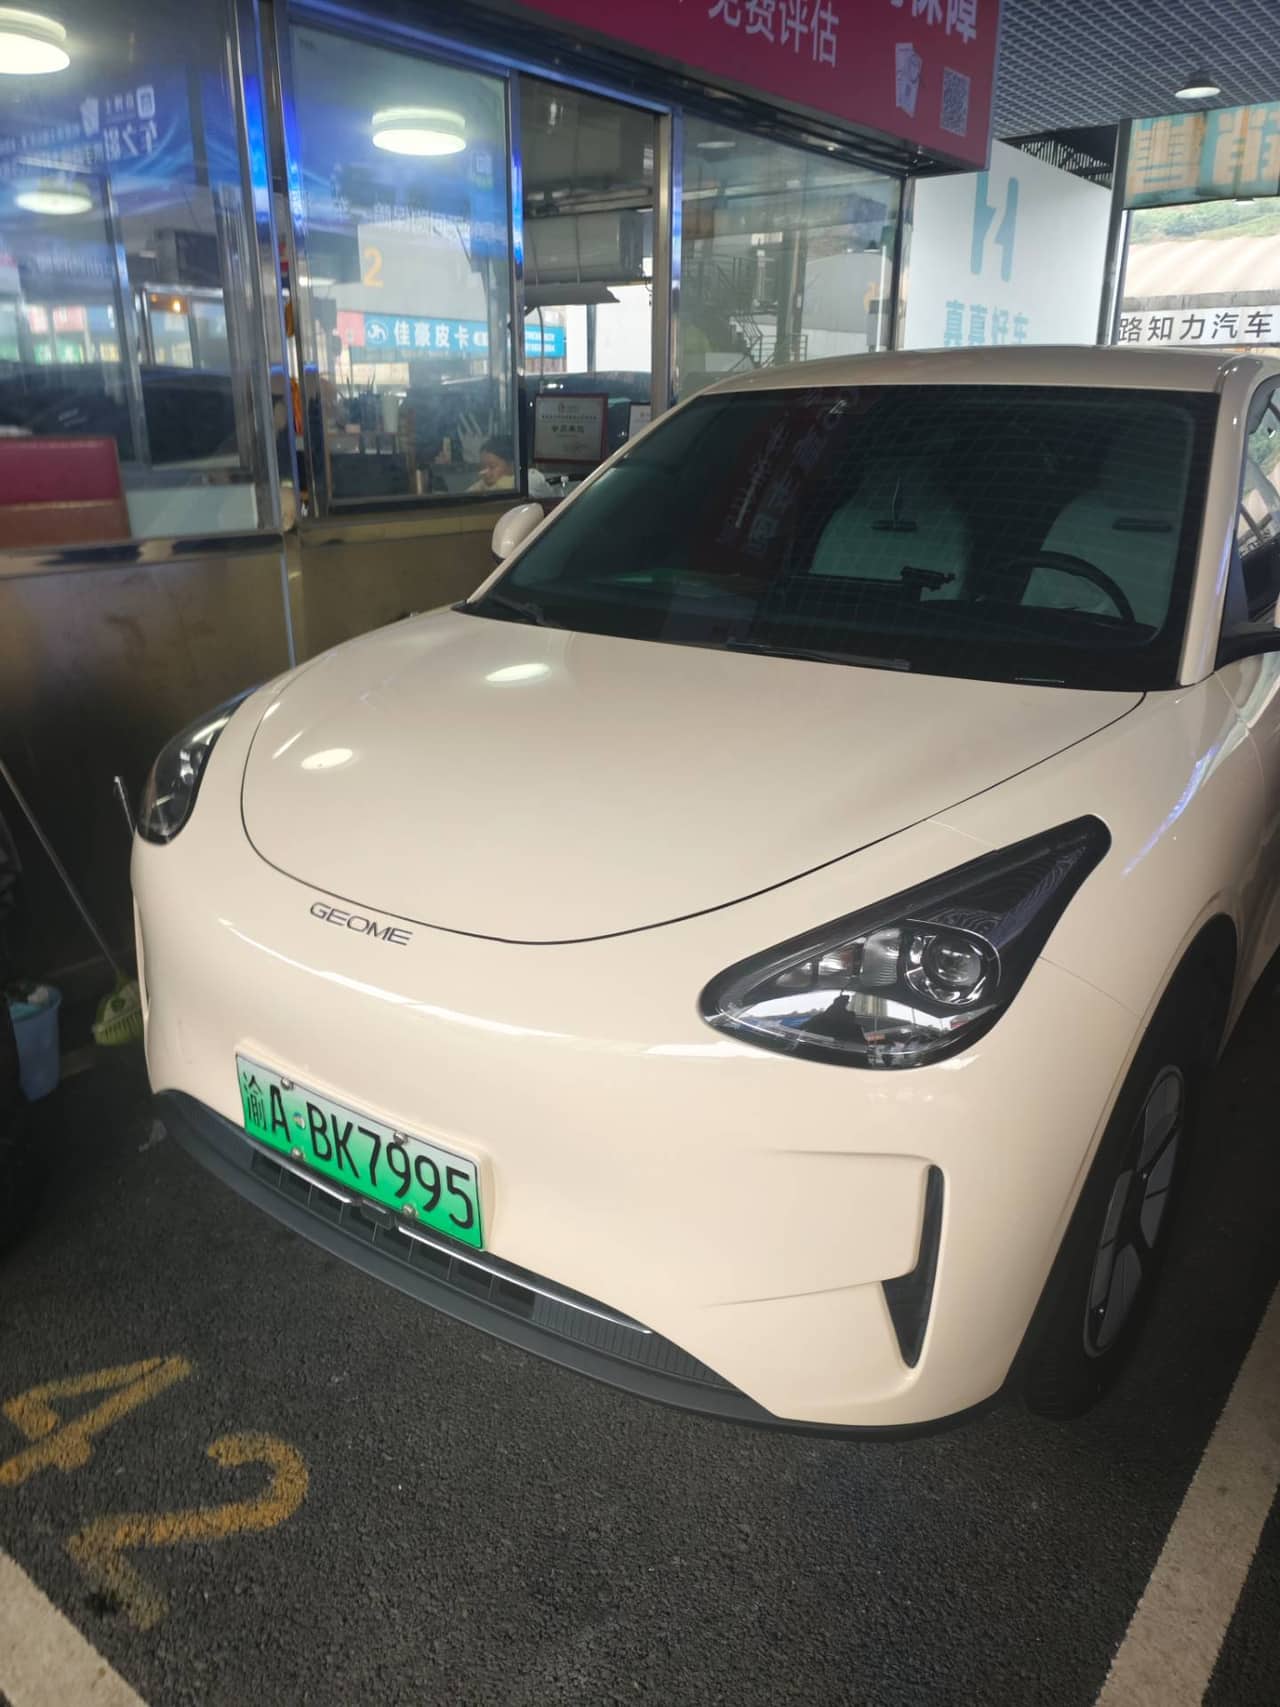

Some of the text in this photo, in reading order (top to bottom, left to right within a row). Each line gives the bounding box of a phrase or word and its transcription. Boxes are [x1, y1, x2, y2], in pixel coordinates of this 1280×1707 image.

[363, 247, 385, 288] 2
[1117, 311, 1273, 343] 路知力汽车
[310, 902, 414, 946] GEOME
